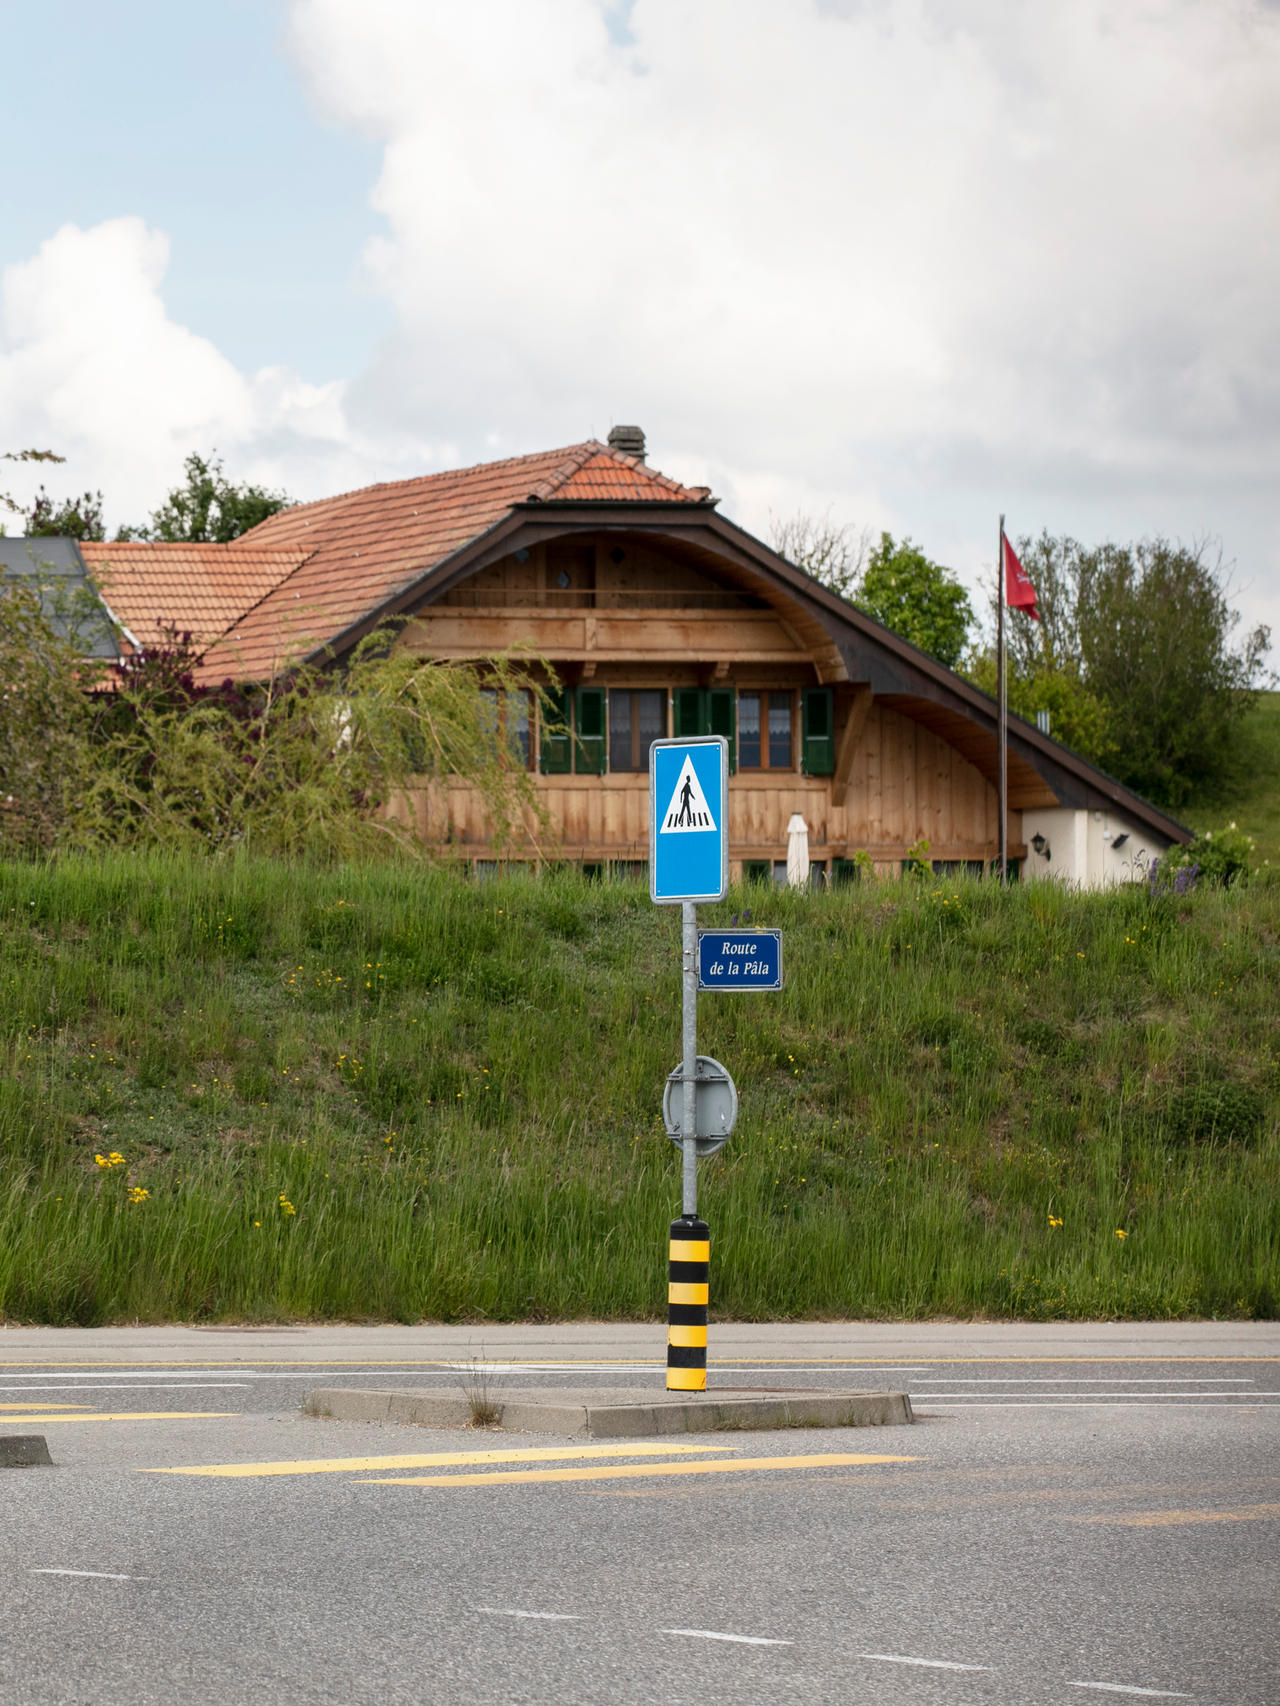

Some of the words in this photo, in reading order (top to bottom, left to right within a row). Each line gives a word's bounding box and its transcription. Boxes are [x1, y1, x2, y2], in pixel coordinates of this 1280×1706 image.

[721, 941, 757, 955] Route
[709, 961, 724, 975] de
[727, 961, 739, 975] la
[743, 960, 769, 975] Pâla
